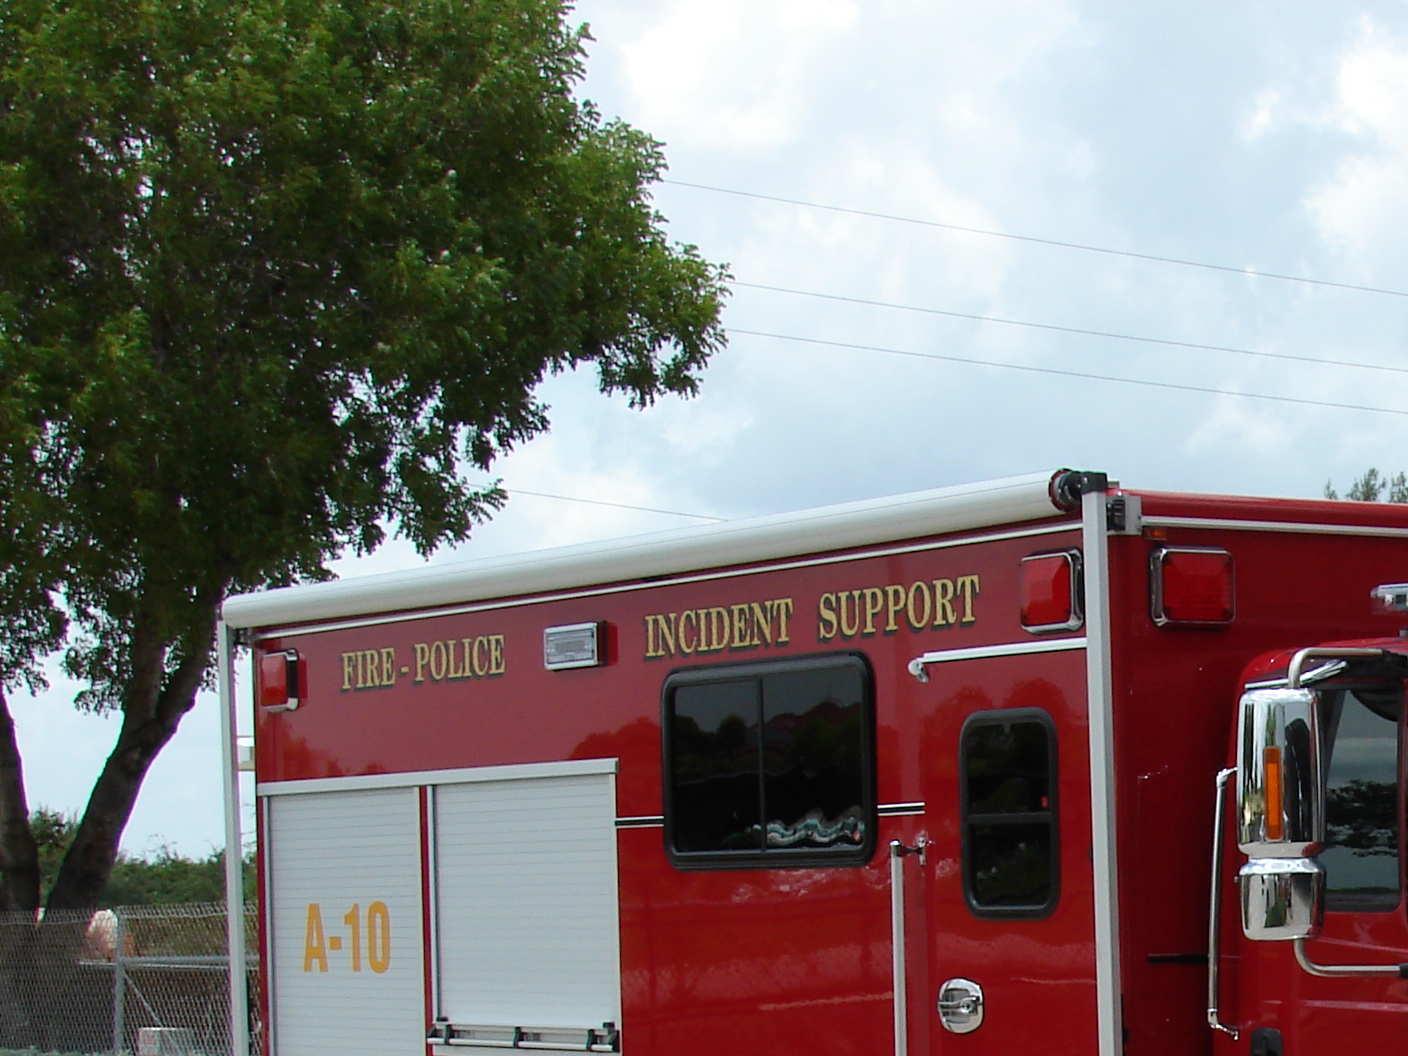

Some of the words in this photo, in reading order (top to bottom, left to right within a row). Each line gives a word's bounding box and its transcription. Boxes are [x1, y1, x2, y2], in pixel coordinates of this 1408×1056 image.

[645, 598, 793, 658] INCIDENT
[819, 574, 980, 639] SUPPORT
[303, 901, 391, 974] A-10
